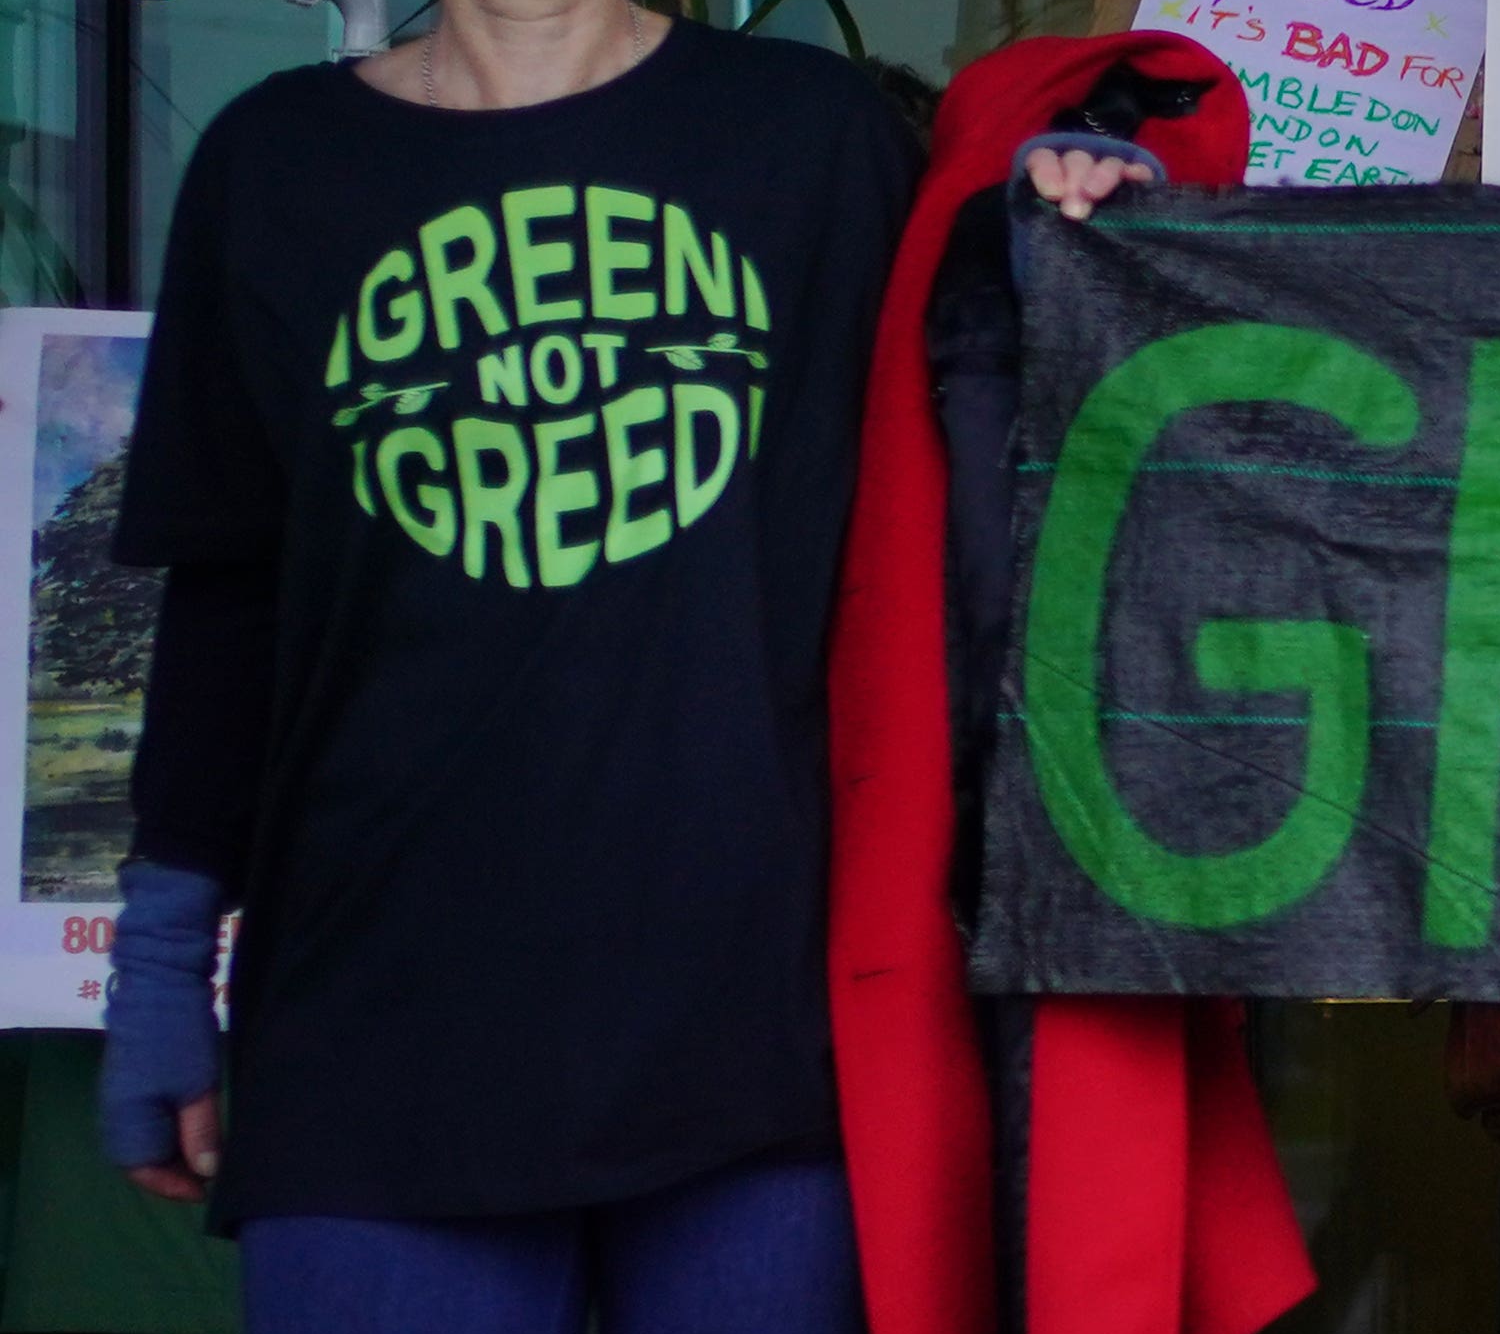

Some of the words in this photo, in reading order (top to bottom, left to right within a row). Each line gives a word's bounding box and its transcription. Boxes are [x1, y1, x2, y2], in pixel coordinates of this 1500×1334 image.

[1186, 5, 1266, 41] IT'S
[1280, 21, 1390, 77] BAD
[1400, 54, 1464, 99] FOR
[1237, 67, 1440, 137] MBLEDON
[357, 184, 737, 362] GREEN
[477, 333, 627, 406] NOT
[375, 383, 741, 589] GREED
